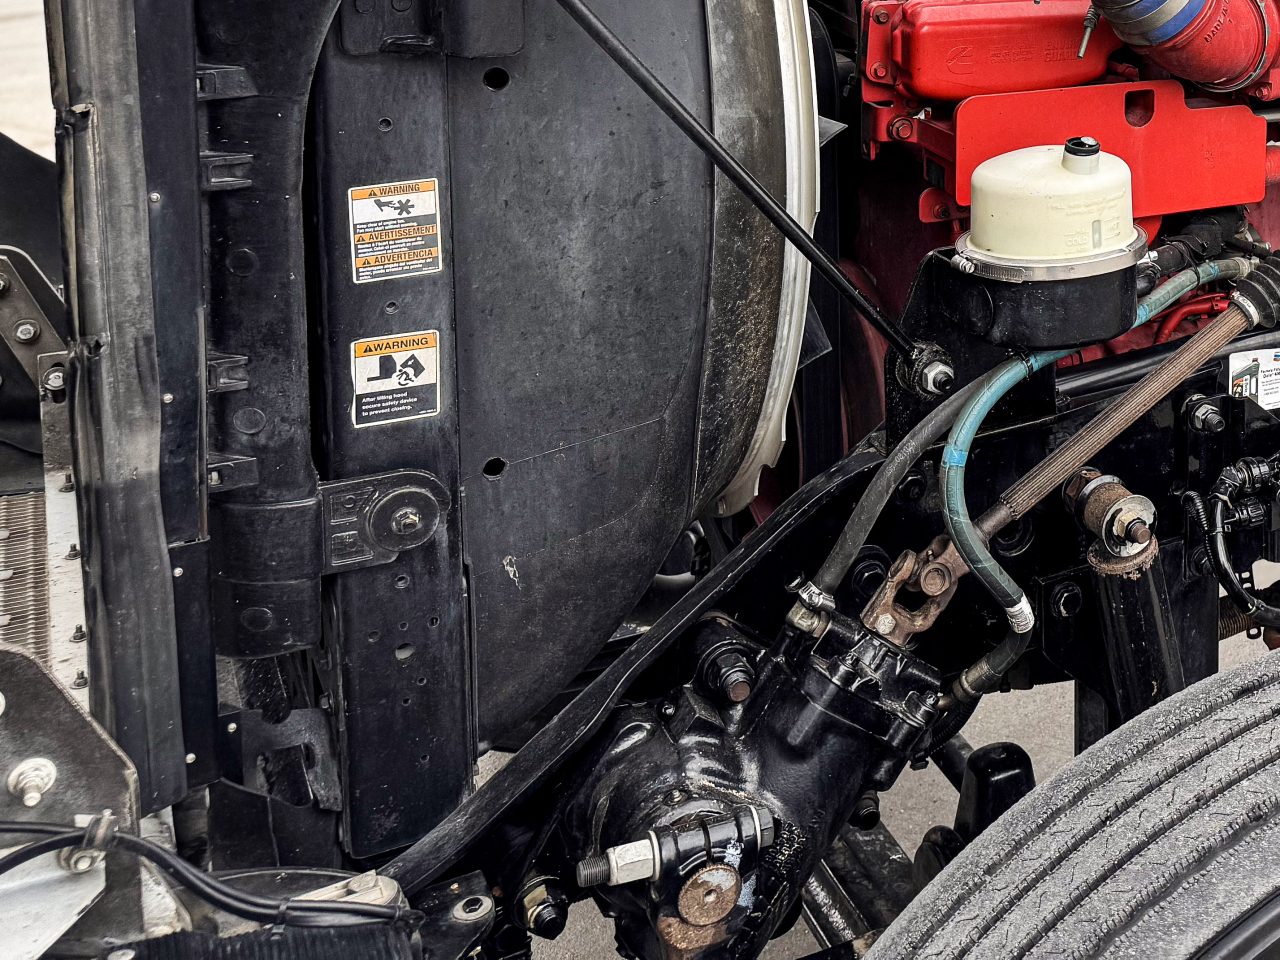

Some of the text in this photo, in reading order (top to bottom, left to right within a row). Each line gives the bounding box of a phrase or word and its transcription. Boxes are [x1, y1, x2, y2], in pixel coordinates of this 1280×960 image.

[379, 183, 420, 196] WARNING
[369, 226, 435, 241] AVERTISSEMENT
[374, 249, 433, 264] ADVERTENCIA
[373, 337, 429, 352] WARNING
